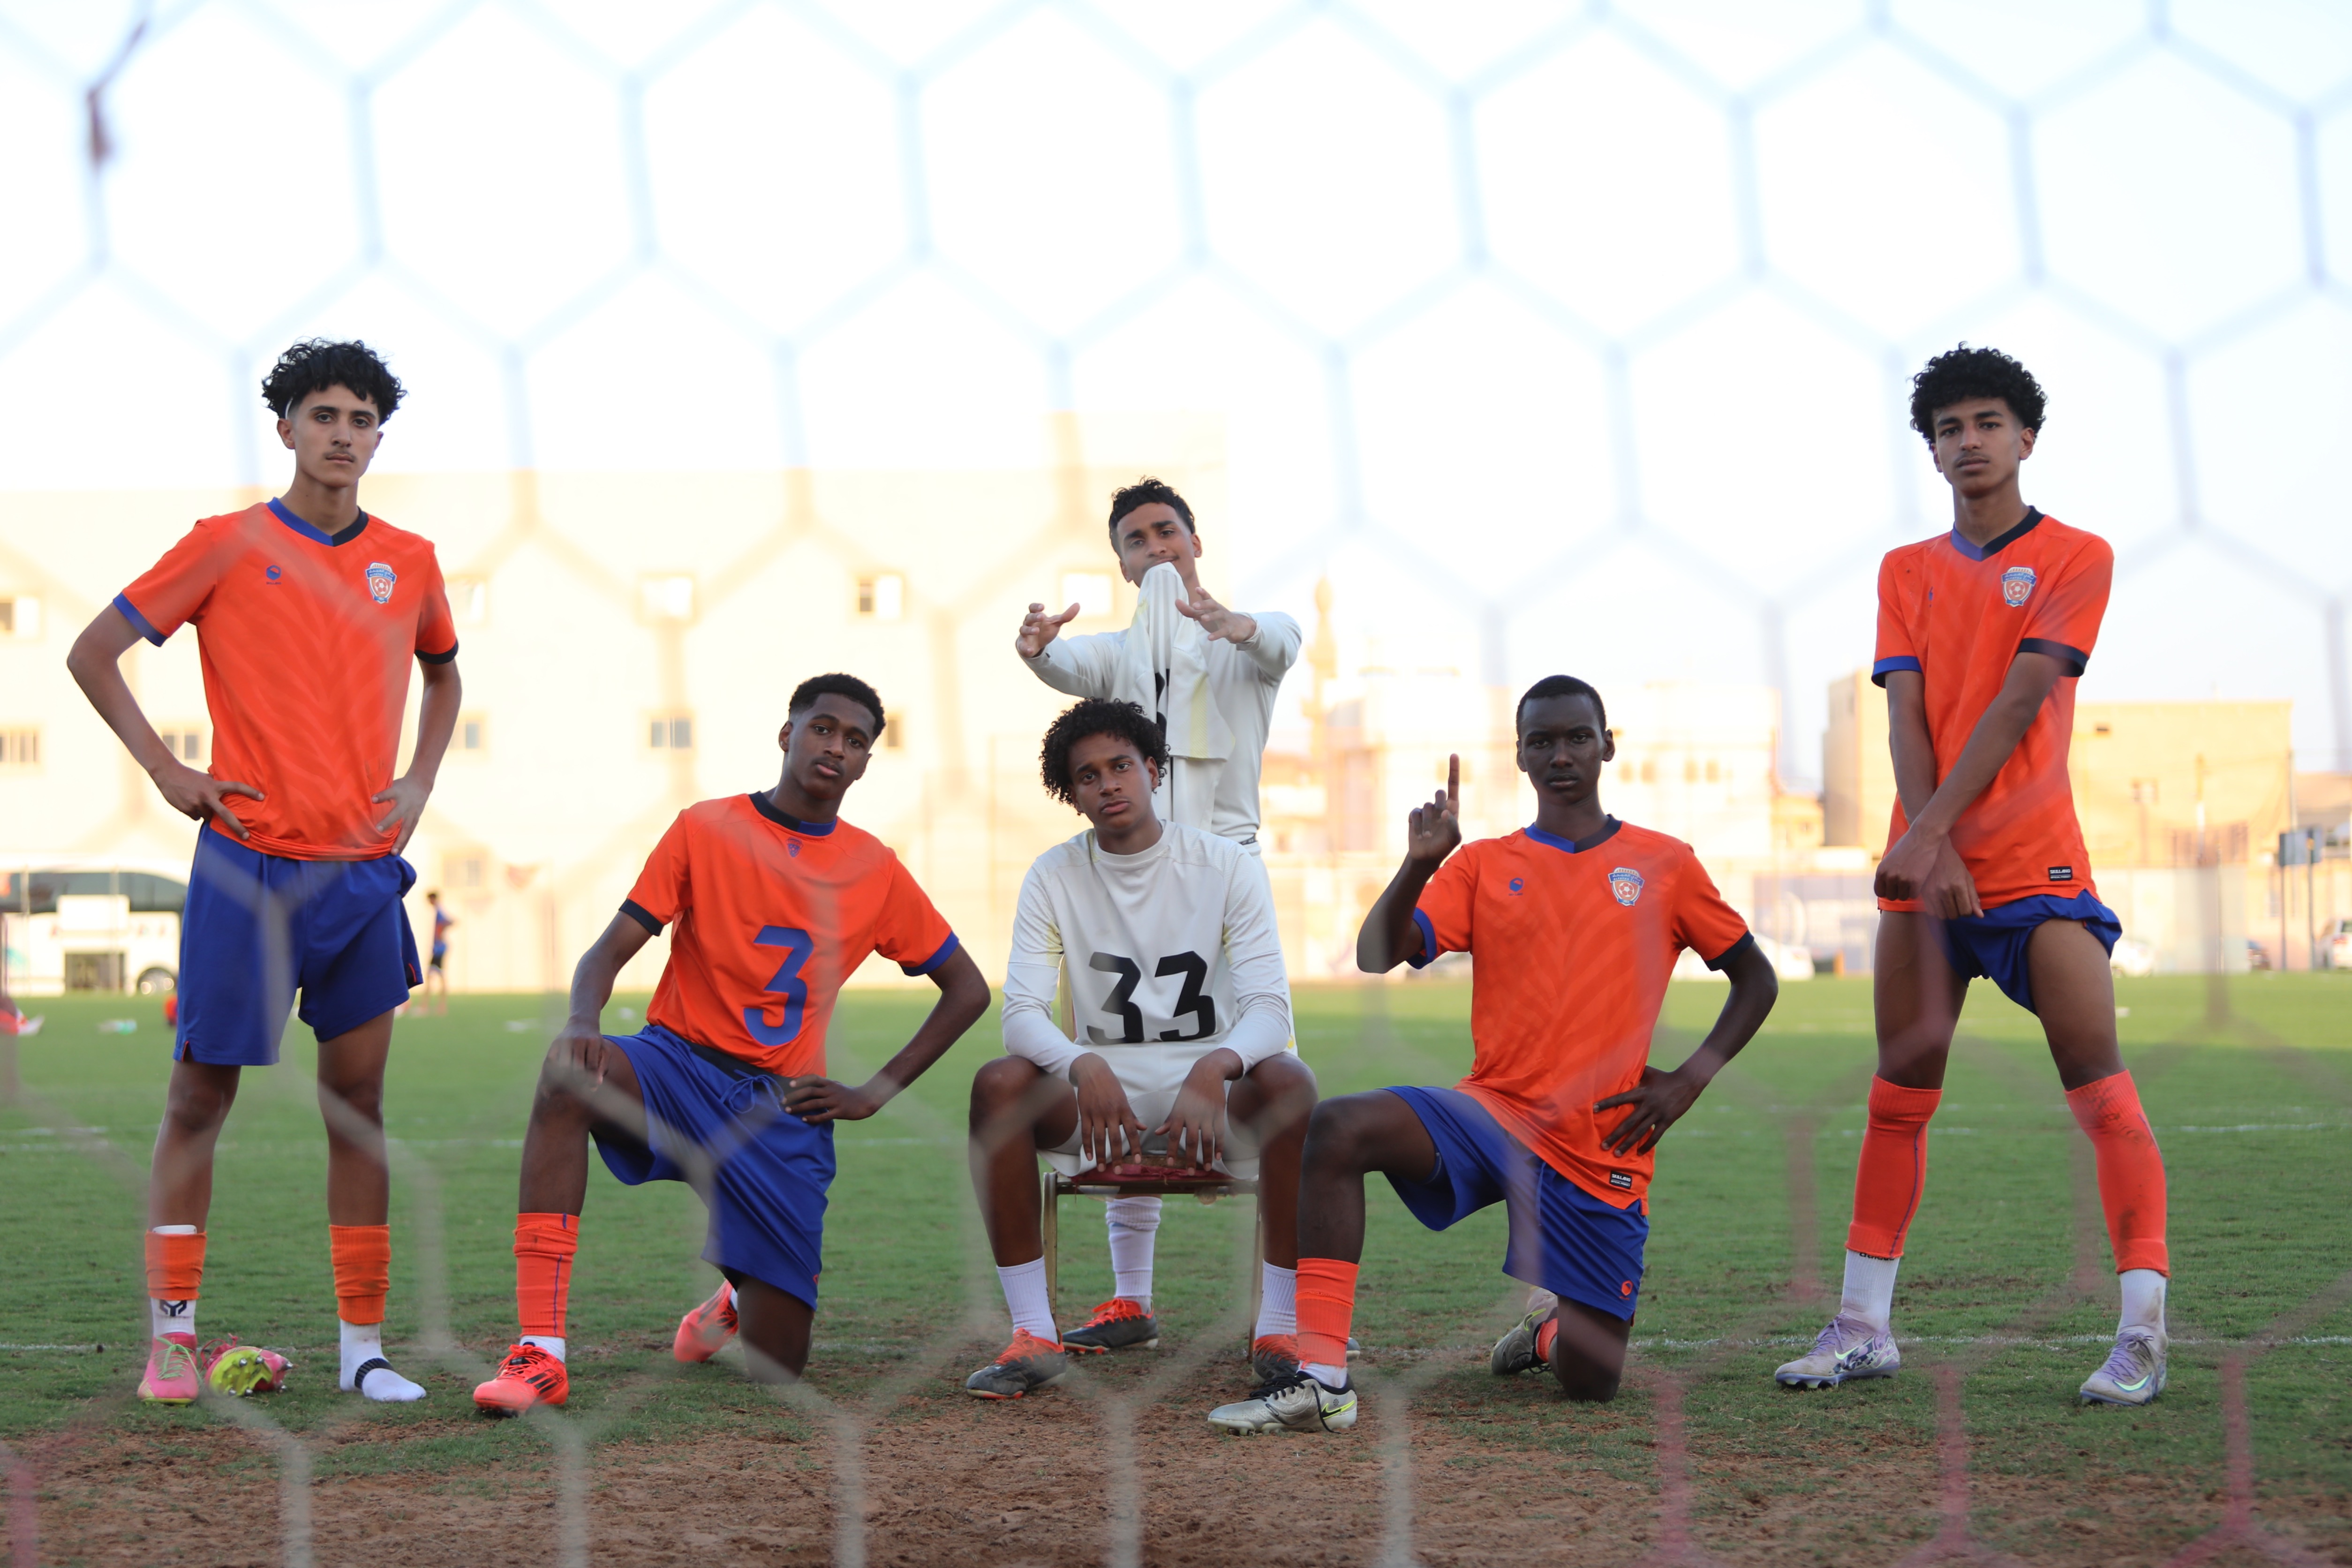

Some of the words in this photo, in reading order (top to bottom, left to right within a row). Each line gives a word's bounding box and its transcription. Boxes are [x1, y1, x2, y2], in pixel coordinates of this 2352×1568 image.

[743, 924, 814, 1047] 3
[1087, 950, 1216, 1045] 33
[544, 1368, 564, 1383] F50
